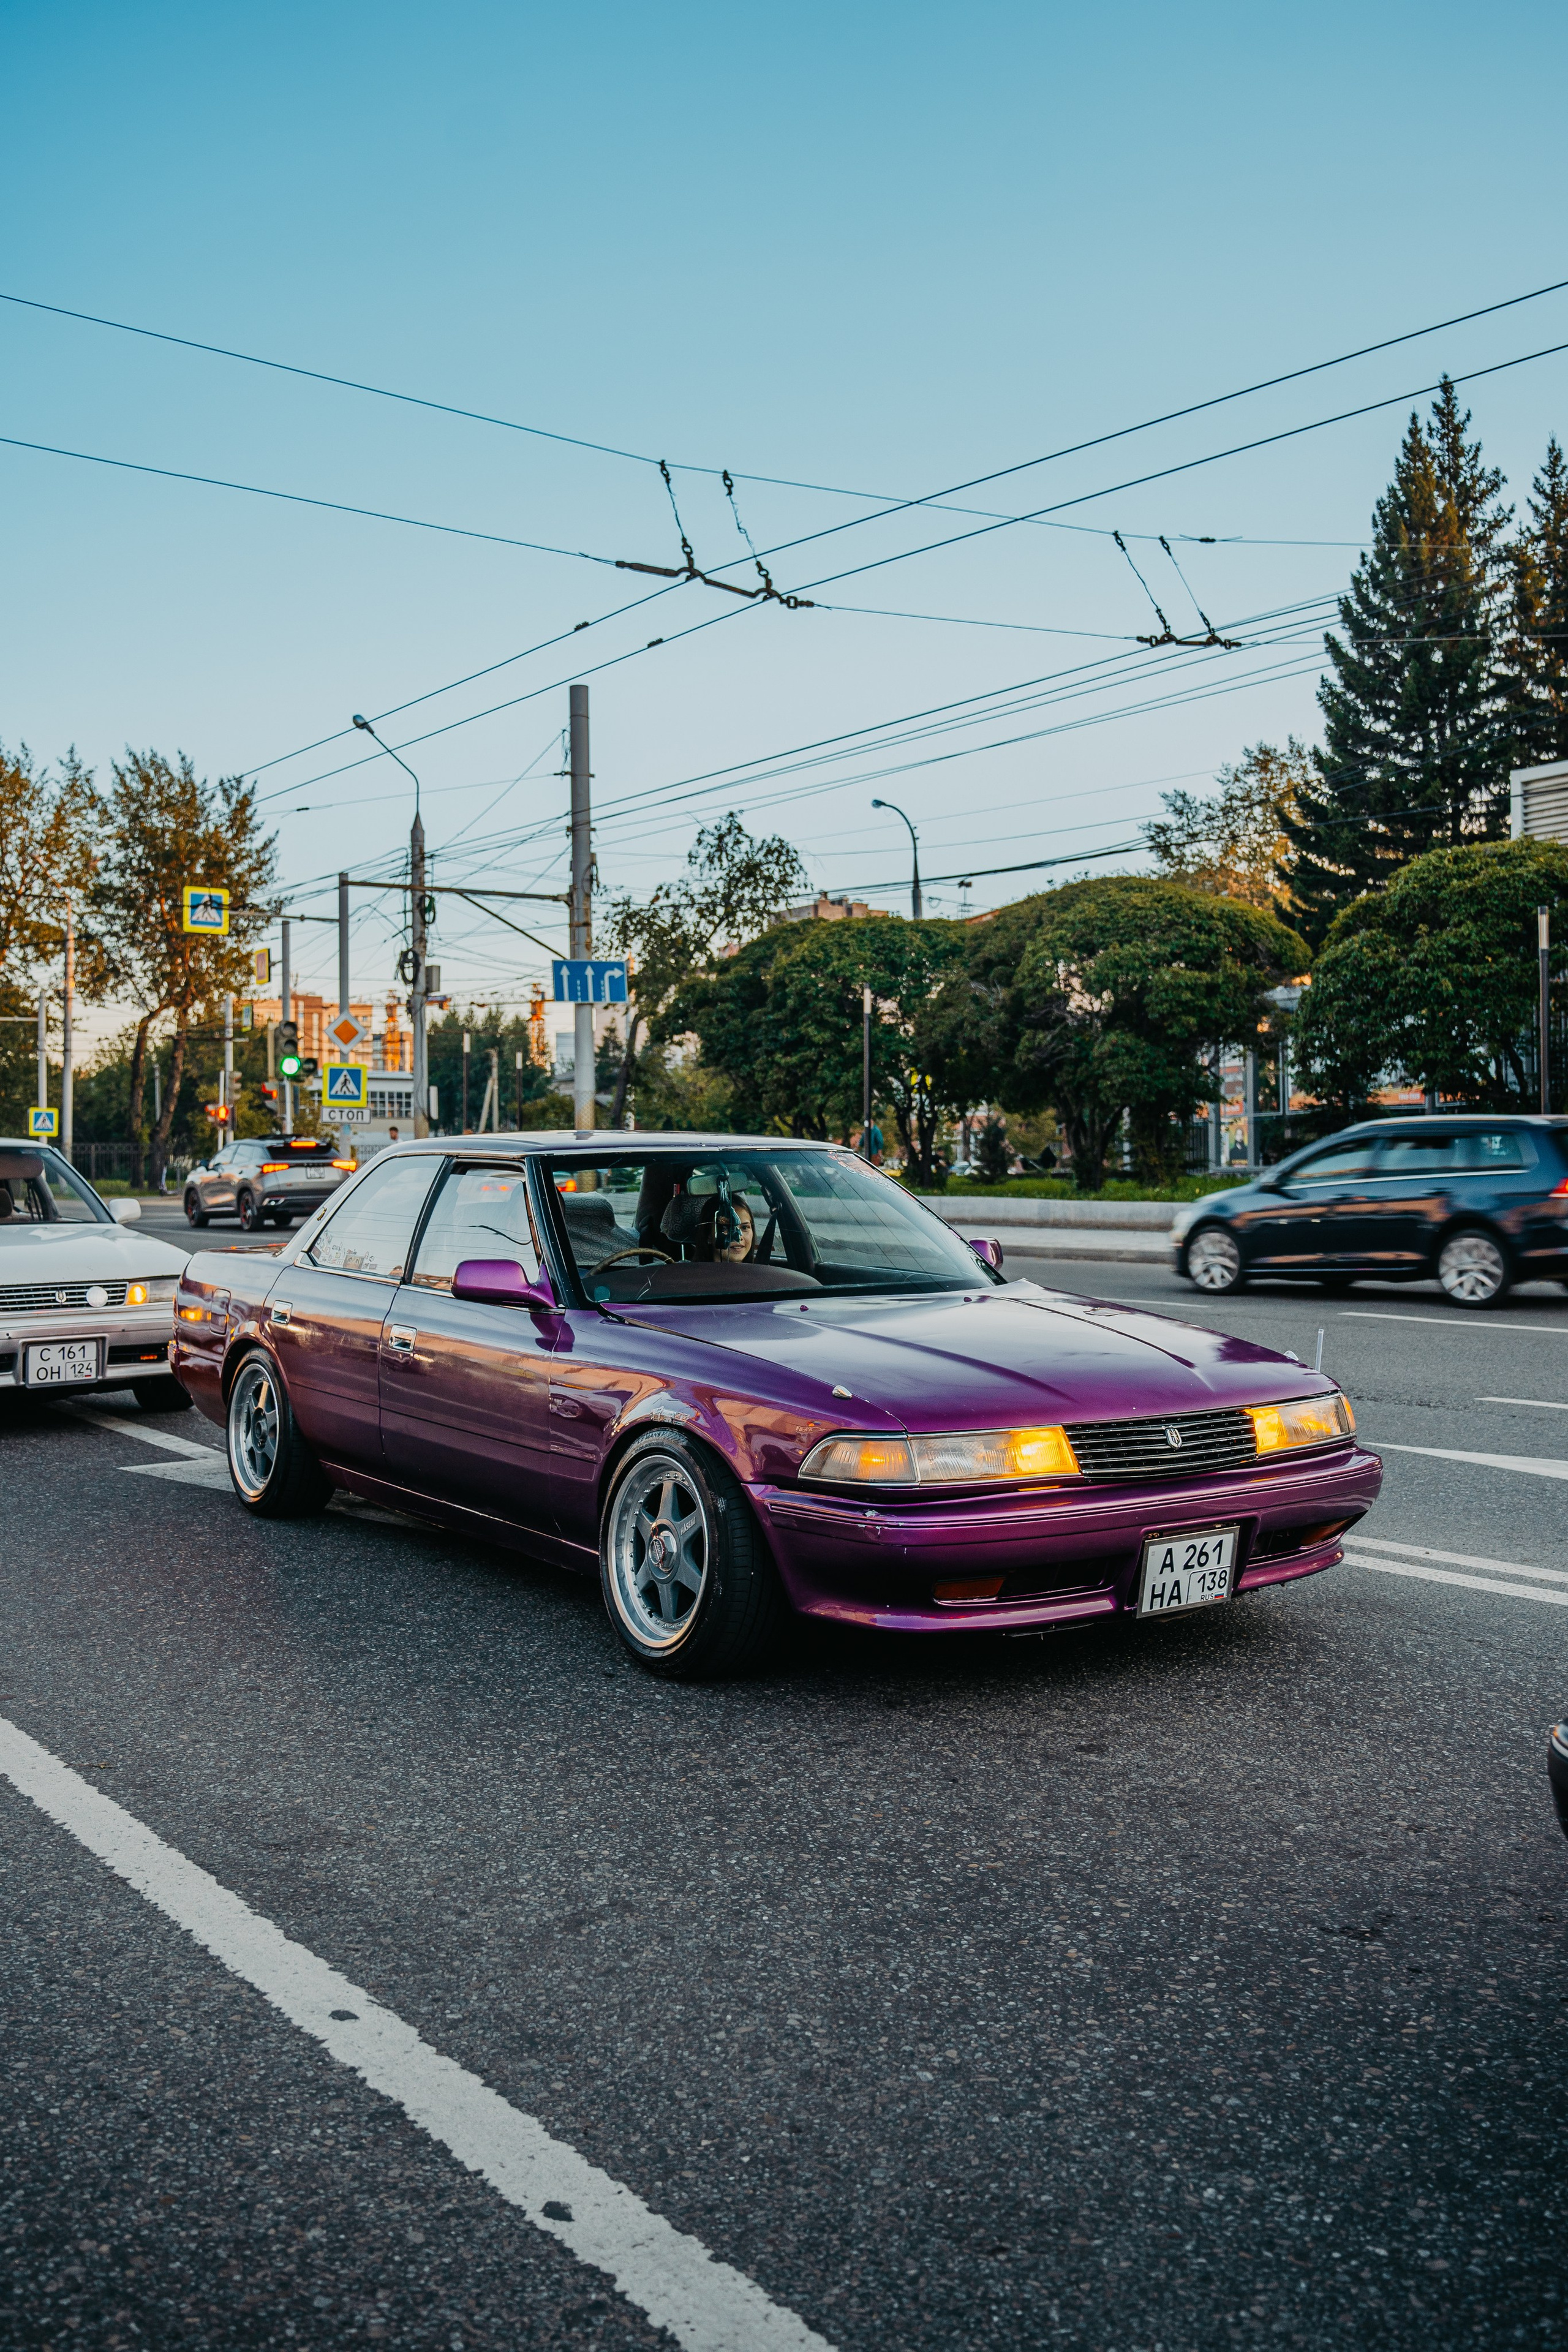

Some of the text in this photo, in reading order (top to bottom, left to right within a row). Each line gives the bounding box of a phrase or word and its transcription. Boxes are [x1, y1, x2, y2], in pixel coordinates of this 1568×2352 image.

[329, 1110, 364, 1121] СТОП
[58, 1344, 86, 1360] 161
[70, 1362, 92, 1374] 124
[1183, 1539, 1224, 1570] 261
[1197, 1569, 1227, 1593] 138
[1200, 1593, 1214, 1602] RUS
